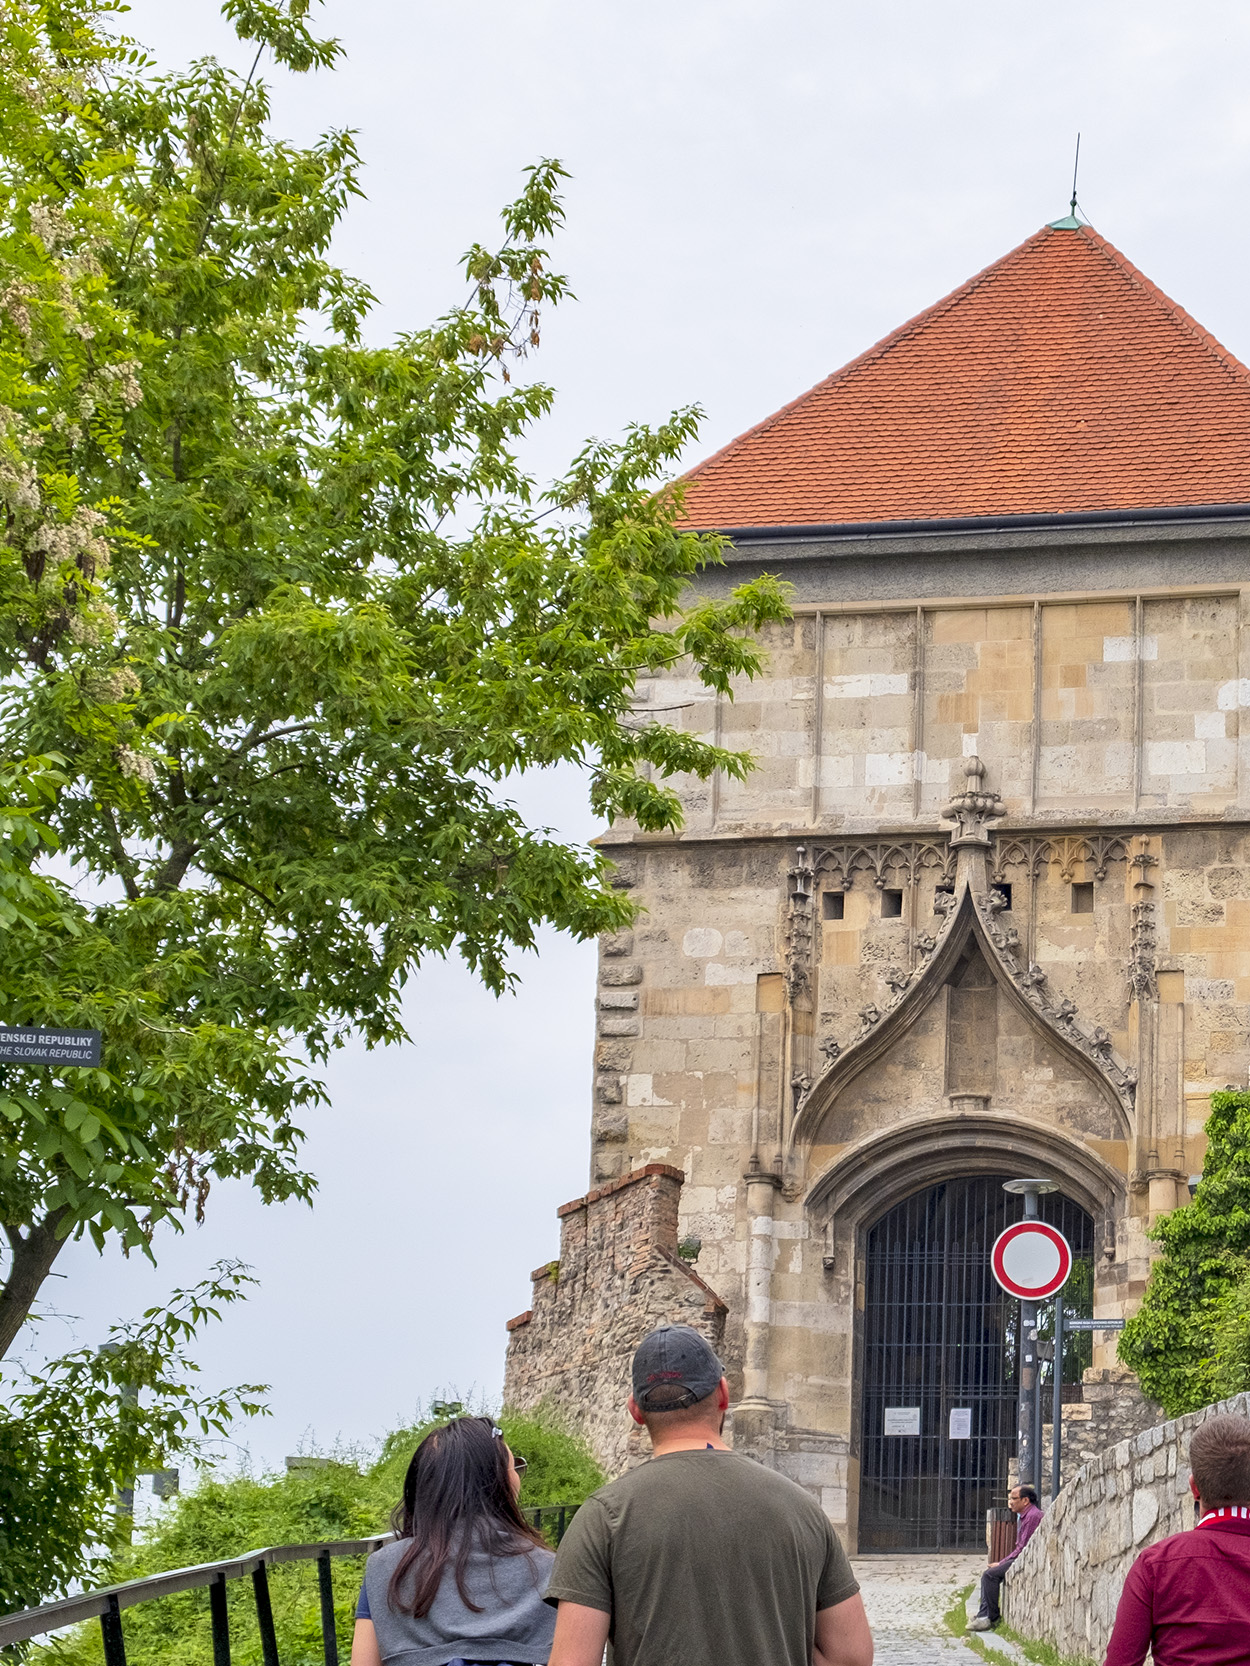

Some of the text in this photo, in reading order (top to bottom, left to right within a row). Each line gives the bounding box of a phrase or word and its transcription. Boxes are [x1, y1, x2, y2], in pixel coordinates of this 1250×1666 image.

[0, 1033, 93, 1046] ENSKEJ REPUBLIKY
[14, 1047, 48, 1057] SLOVAK
[49, 1048, 93, 1059] REPUBLIC
